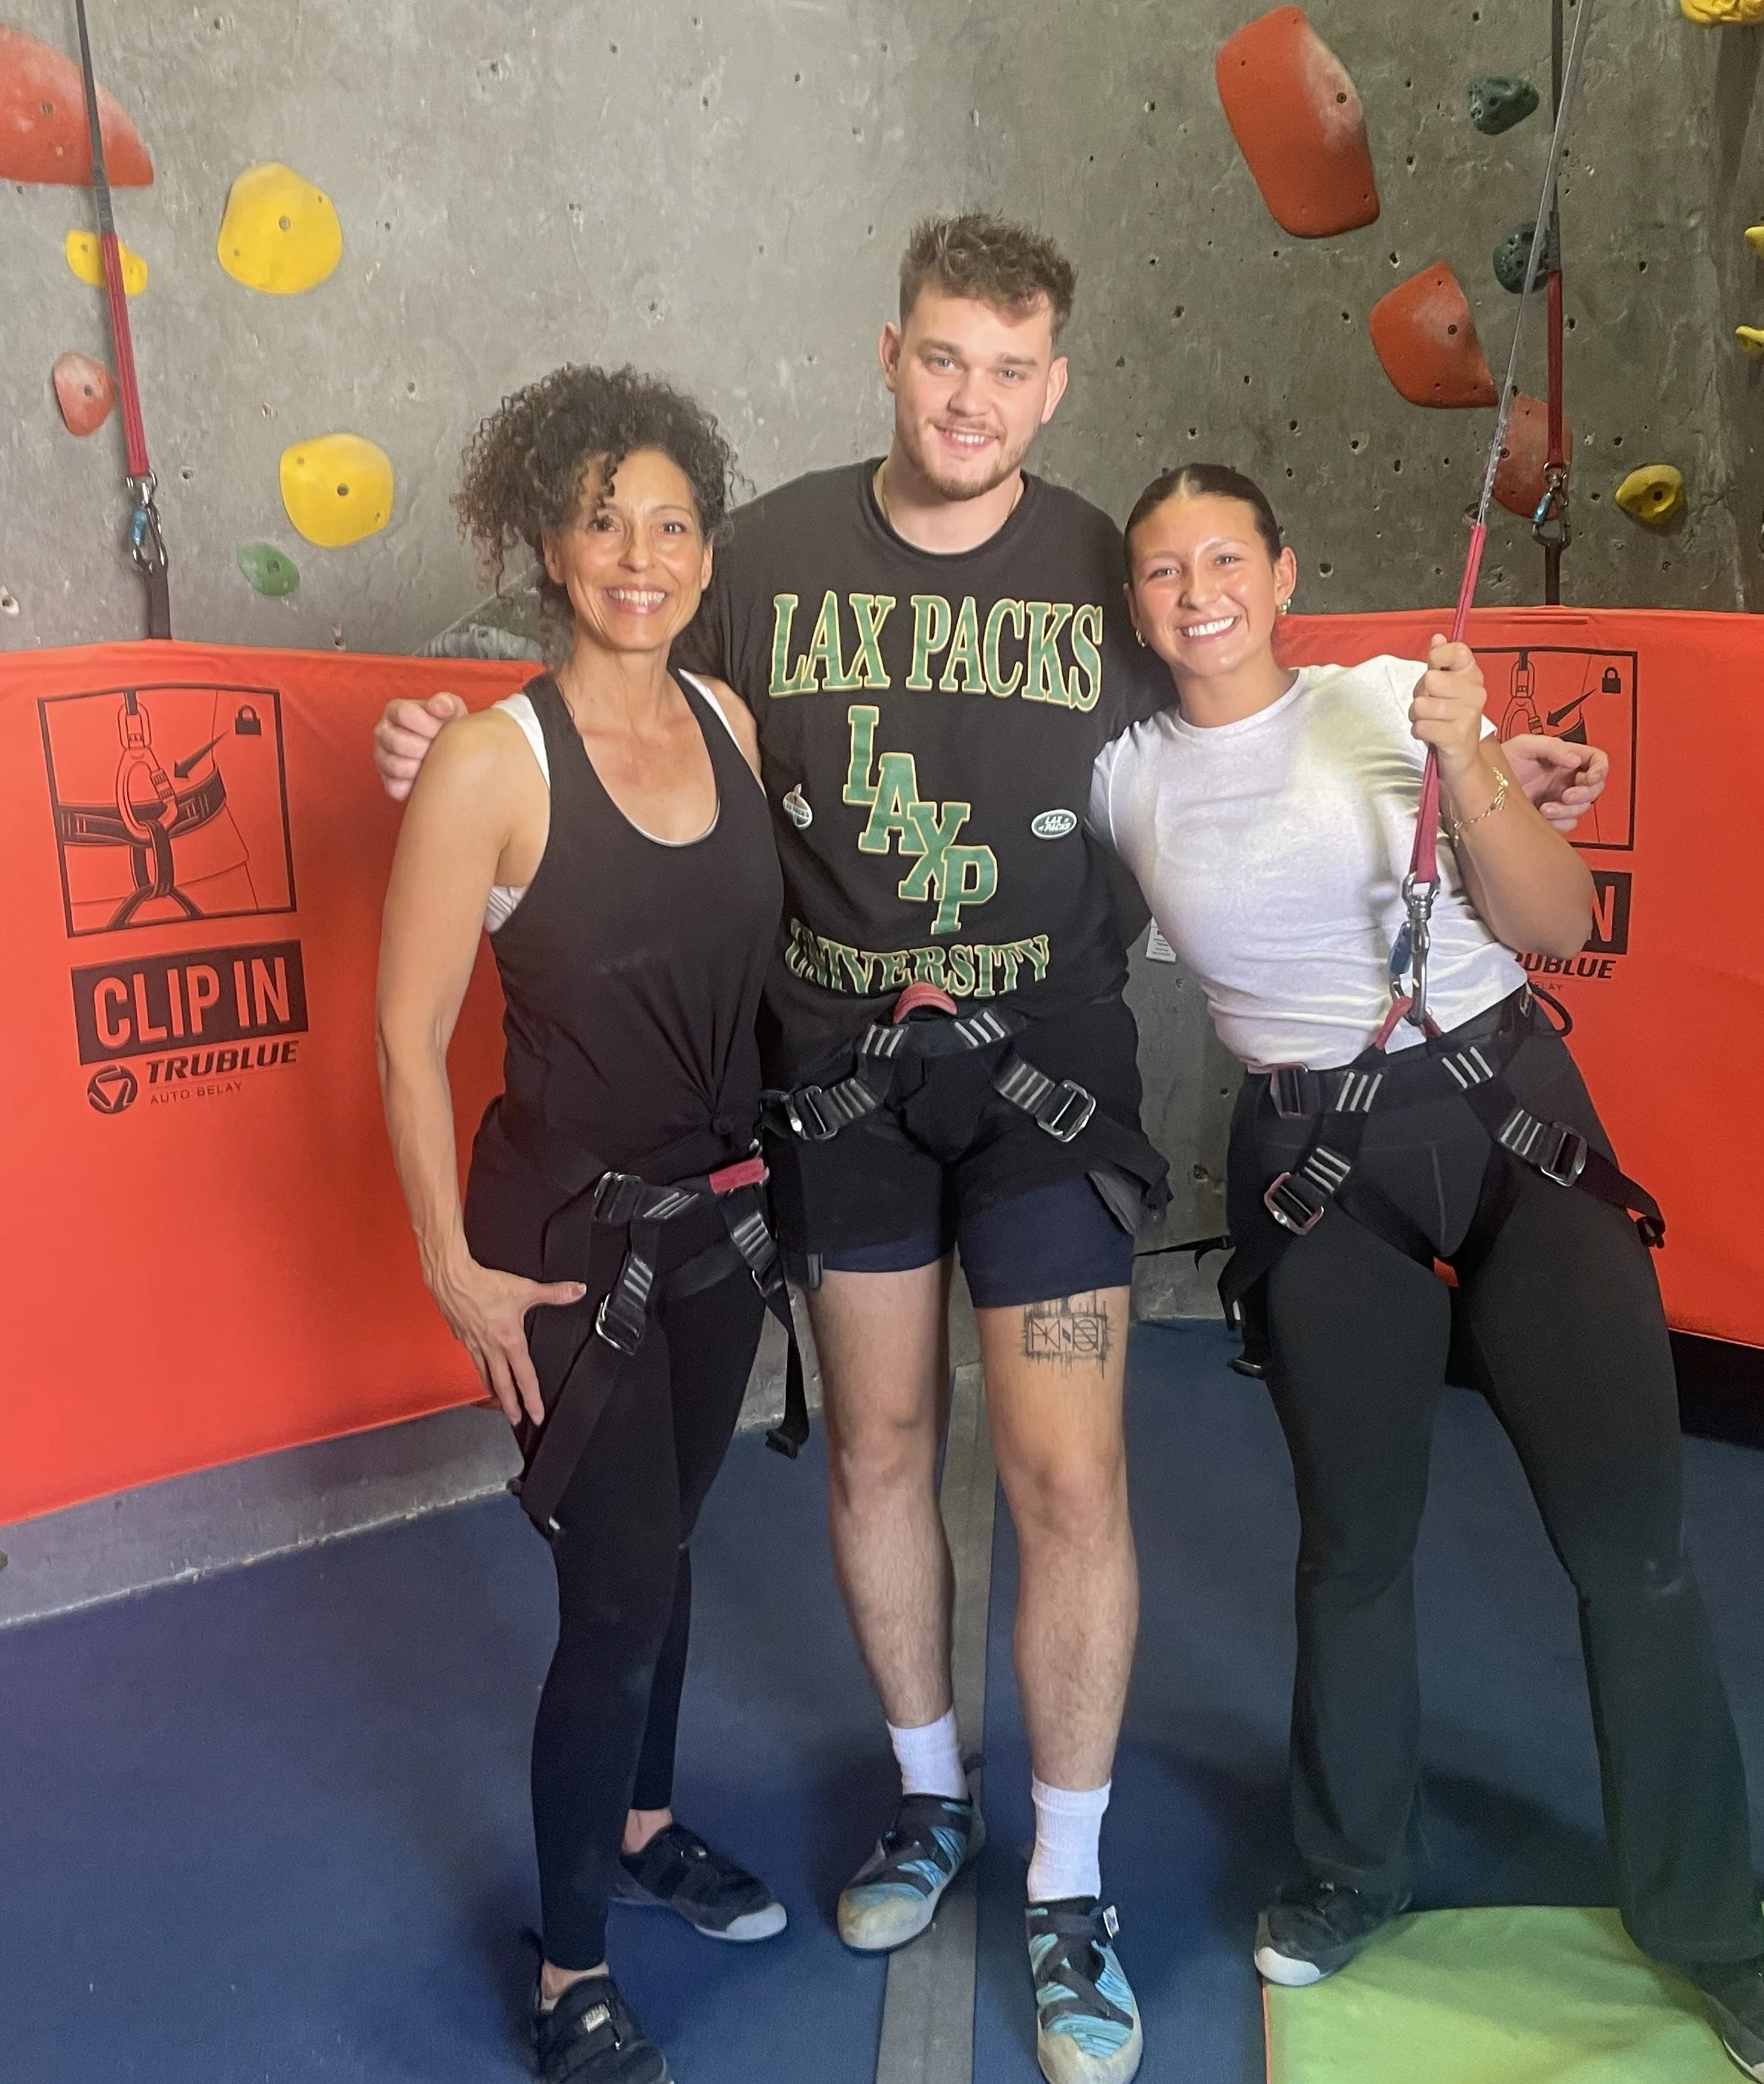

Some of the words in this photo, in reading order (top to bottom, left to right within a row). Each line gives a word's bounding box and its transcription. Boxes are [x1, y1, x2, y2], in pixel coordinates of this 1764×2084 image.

[769, 590, 896, 697] LAX
[905, 594, 1103, 713] PACKS
[93, 964, 220, 1049] CLIP
[233, 957, 290, 1029] IN
[146, 1041, 299, 1084] TRUBLUE
[150, 1089, 190, 1105] AUTO
[196, 1081, 243, 1099] BELAY
